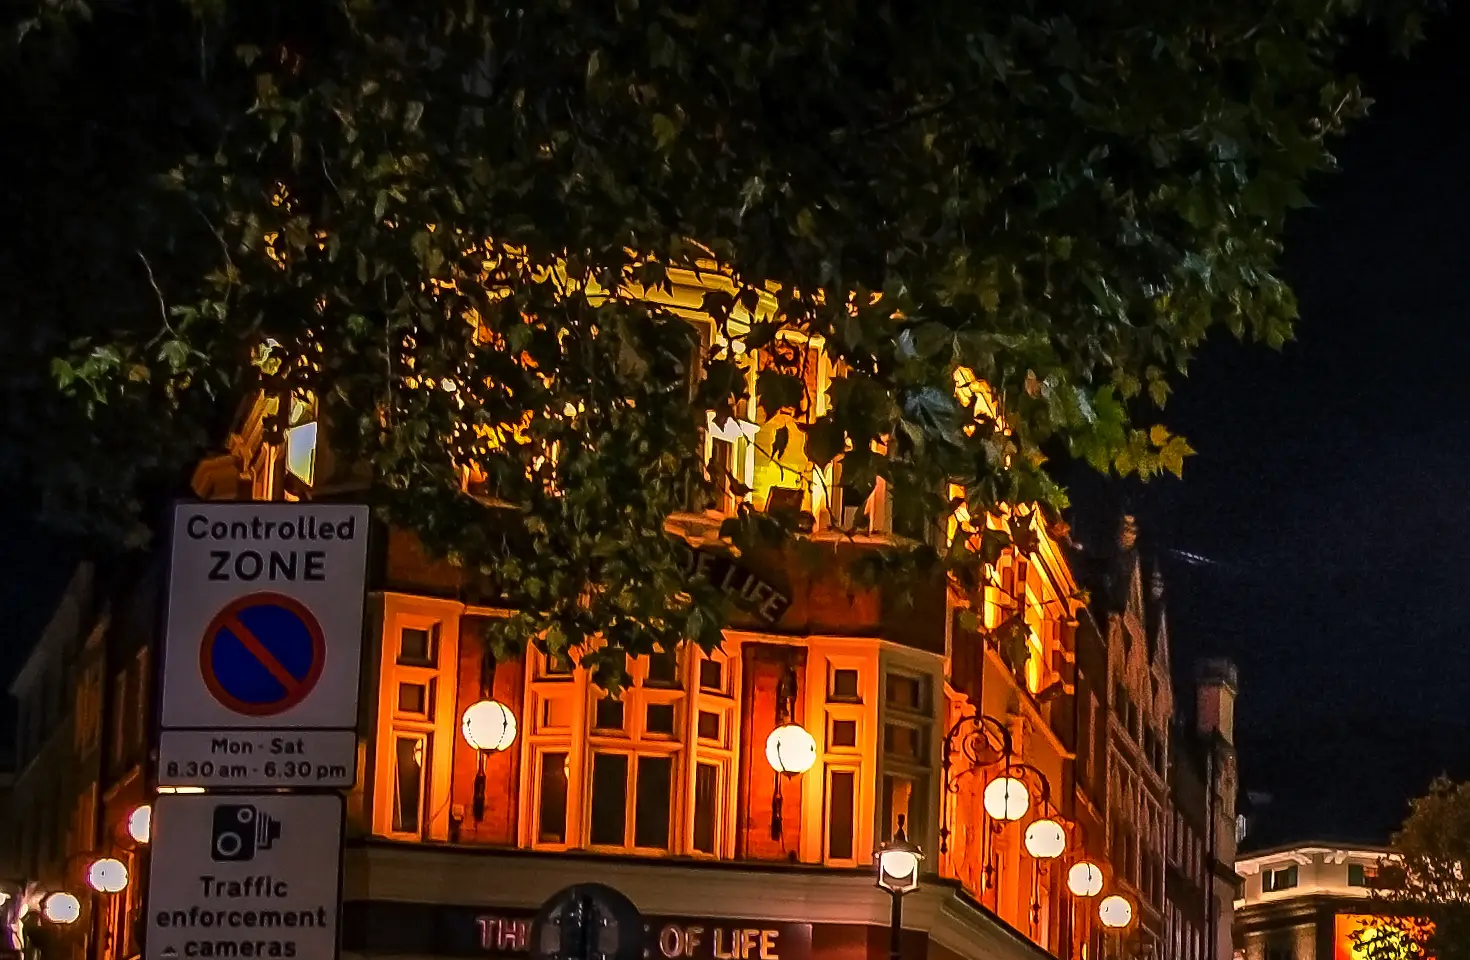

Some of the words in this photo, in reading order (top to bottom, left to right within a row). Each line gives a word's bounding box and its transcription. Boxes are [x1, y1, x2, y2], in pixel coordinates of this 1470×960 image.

[187, 515, 355, 540] Controlled
[208, 550, 326, 581] ZONE
[212, 738, 253, 754] Mon
[271, 738, 304, 754] Sat
[167, 761, 213, 778] 8.30
[219, 765, 247, 778] am
[264, 761, 311, 778] 6.30
[317, 764, 346, 779] pm
[200, 876, 288, 897] Traffic
[156, 907, 326, 928] enforcement
[184, 941, 297, 957] cameras
[659, 925, 703, 958] OF
[714, 928, 779, 960] LIFE
